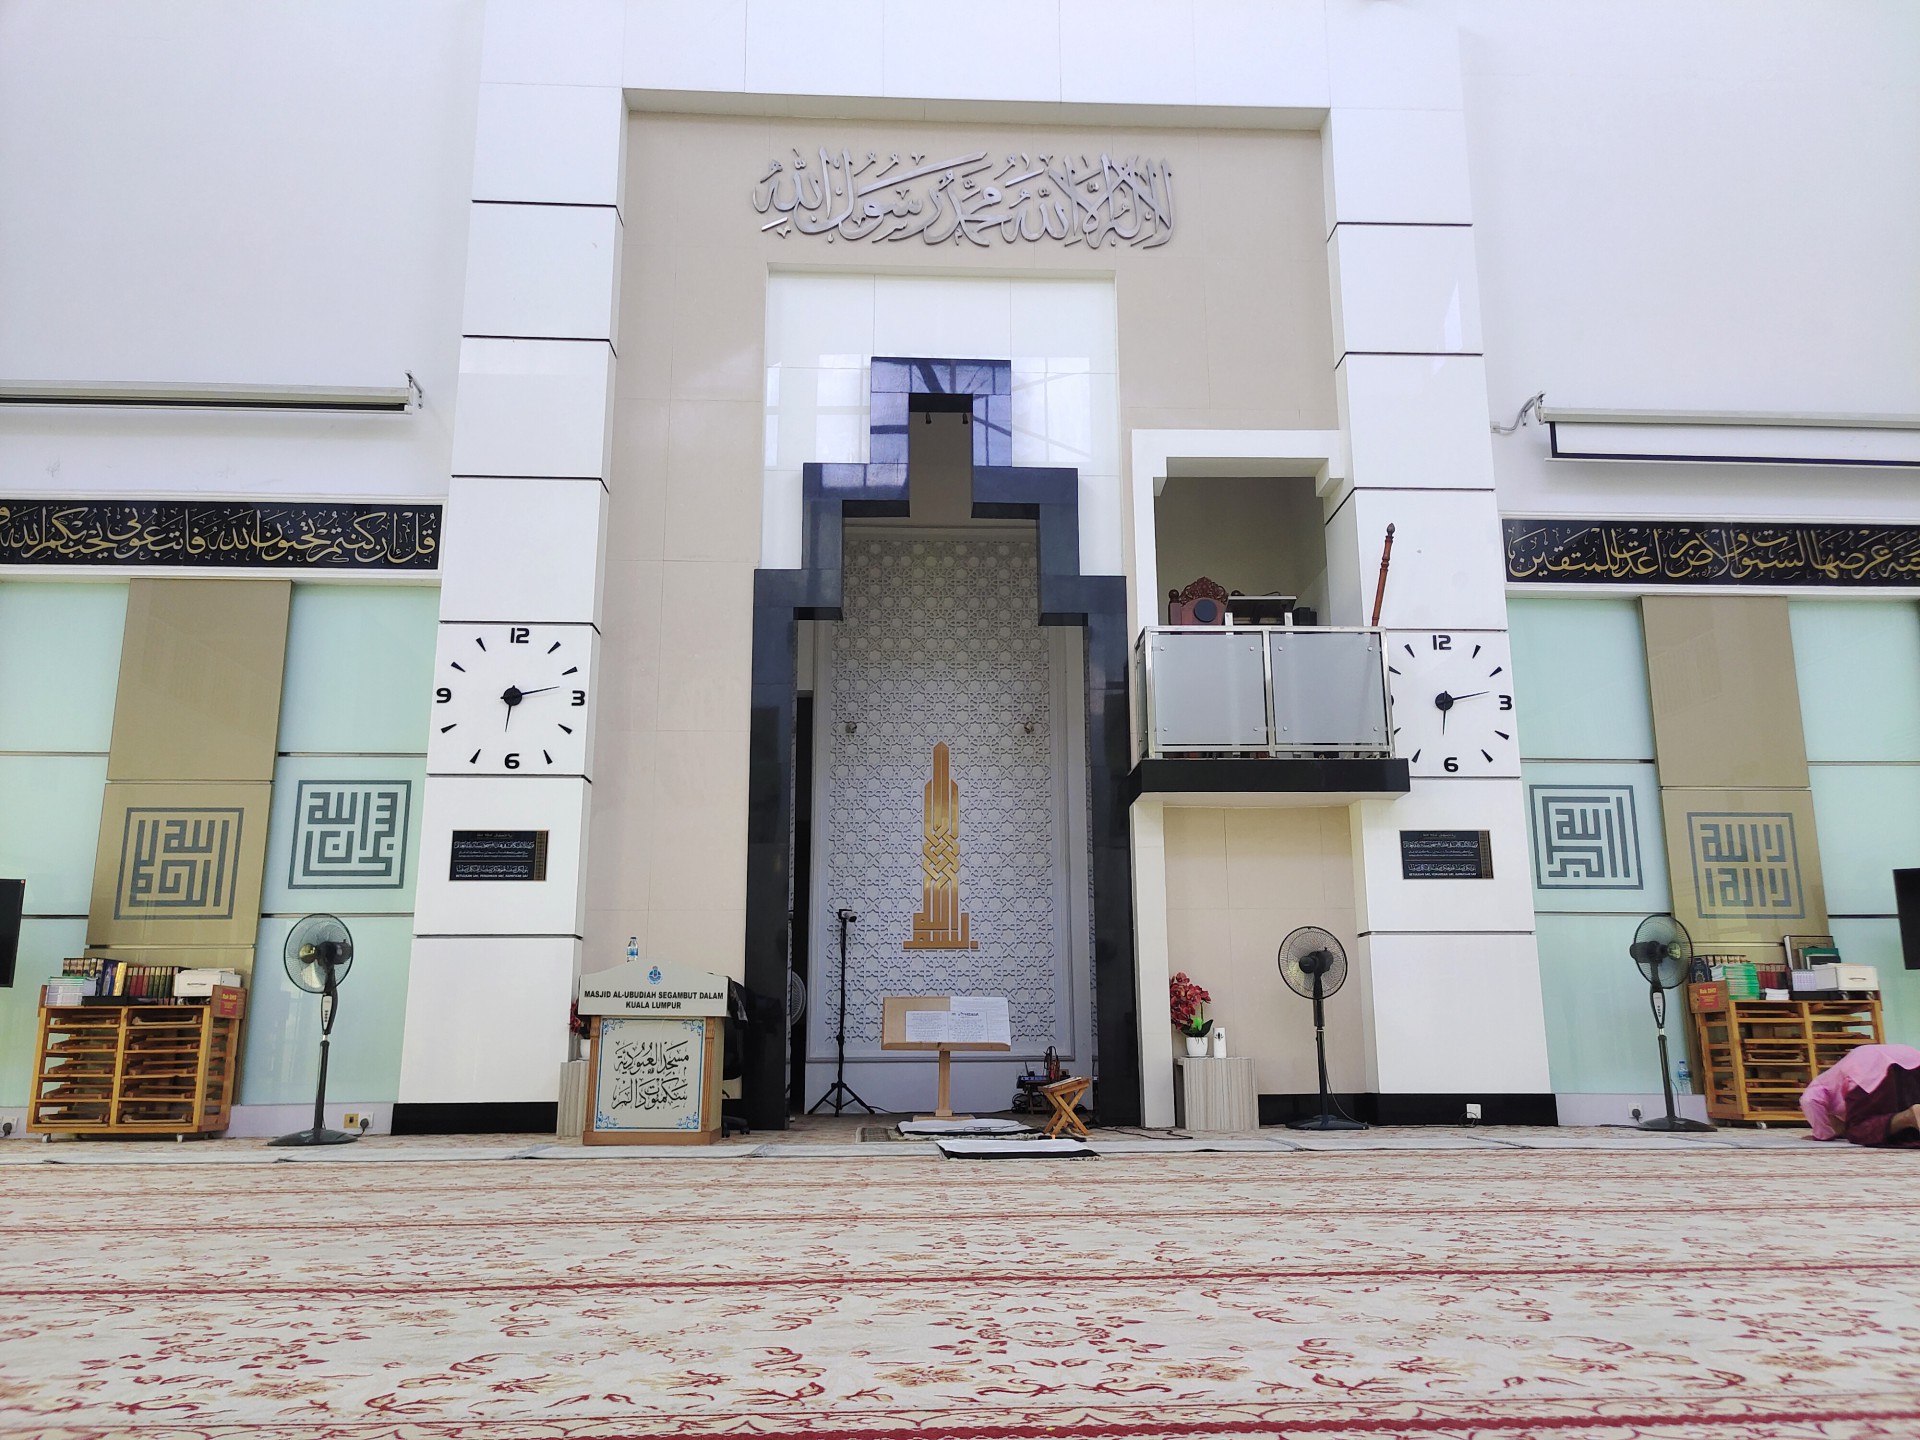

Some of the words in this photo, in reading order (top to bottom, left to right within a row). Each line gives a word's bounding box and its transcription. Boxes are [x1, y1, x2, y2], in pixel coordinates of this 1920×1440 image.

[510, 627, 530, 644] 12
[1432, 634, 1452, 651] 12
[436, 687, 452, 704] 9
[571, 690, 586, 707] 3
[1498, 694, 1513, 711] 3
[504, 752, 520, 770] 6
[1443, 756, 1459, 773] 6
[584, 990, 611, 998] MASJID
[613, 991, 657, 999] AL-UBUDIAH
[658, 991, 698, 999] SEGAMBUT
[699, 992, 724, 1000] DALAM
[625, 1001, 650, 1009] KUALA
[651, 1001, 682, 1009] LUMPUR
